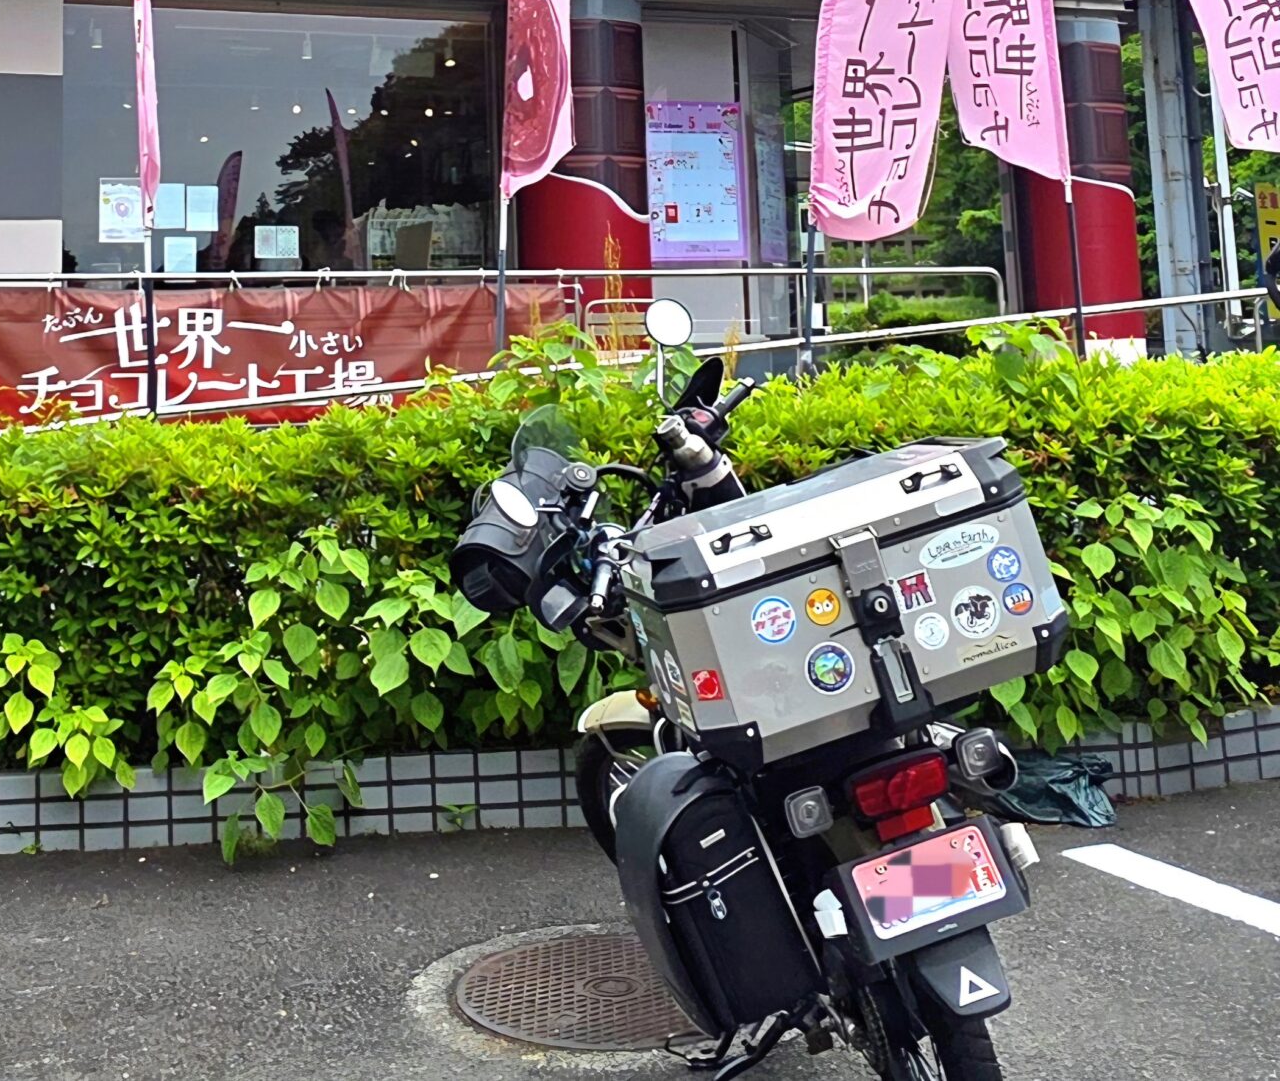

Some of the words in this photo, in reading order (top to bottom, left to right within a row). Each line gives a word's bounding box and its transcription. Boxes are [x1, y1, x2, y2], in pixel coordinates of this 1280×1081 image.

[43, 307, 103, 334] たぶん
[59, 302, 295, 370] 世界一
[289, 330, 364, 358] 小さい
[963, 640, 1018, 664] nomadica
